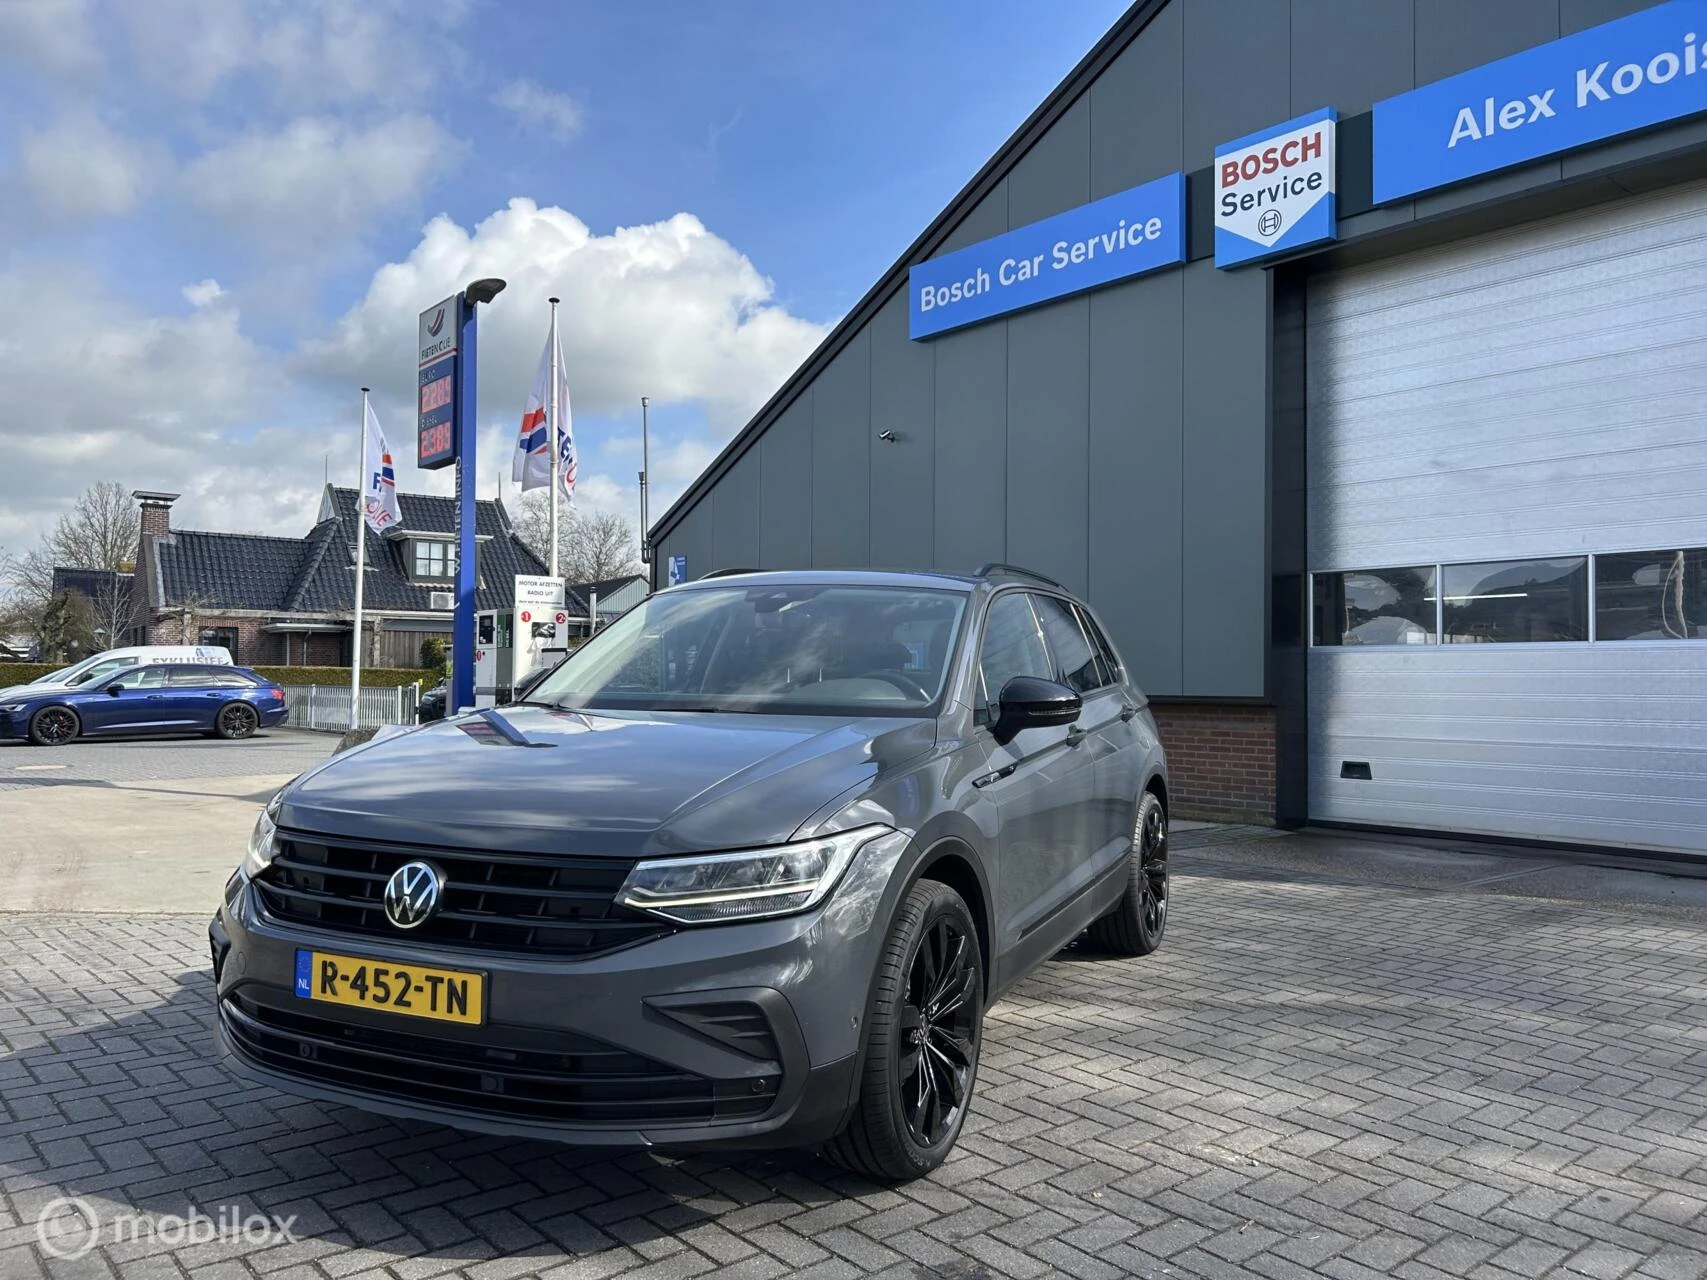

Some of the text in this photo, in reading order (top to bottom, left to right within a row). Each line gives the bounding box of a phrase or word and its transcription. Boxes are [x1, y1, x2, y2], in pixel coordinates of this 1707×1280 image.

[1447, 31, 1707, 149] Alex Kooi
[1221, 131, 1322, 189] BOSCH
[1220, 171, 1323, 217] Service
[920, 216, 1163, 313] Bosch Car Service
[298, 959, 468, 1017] NL R-452-TN
